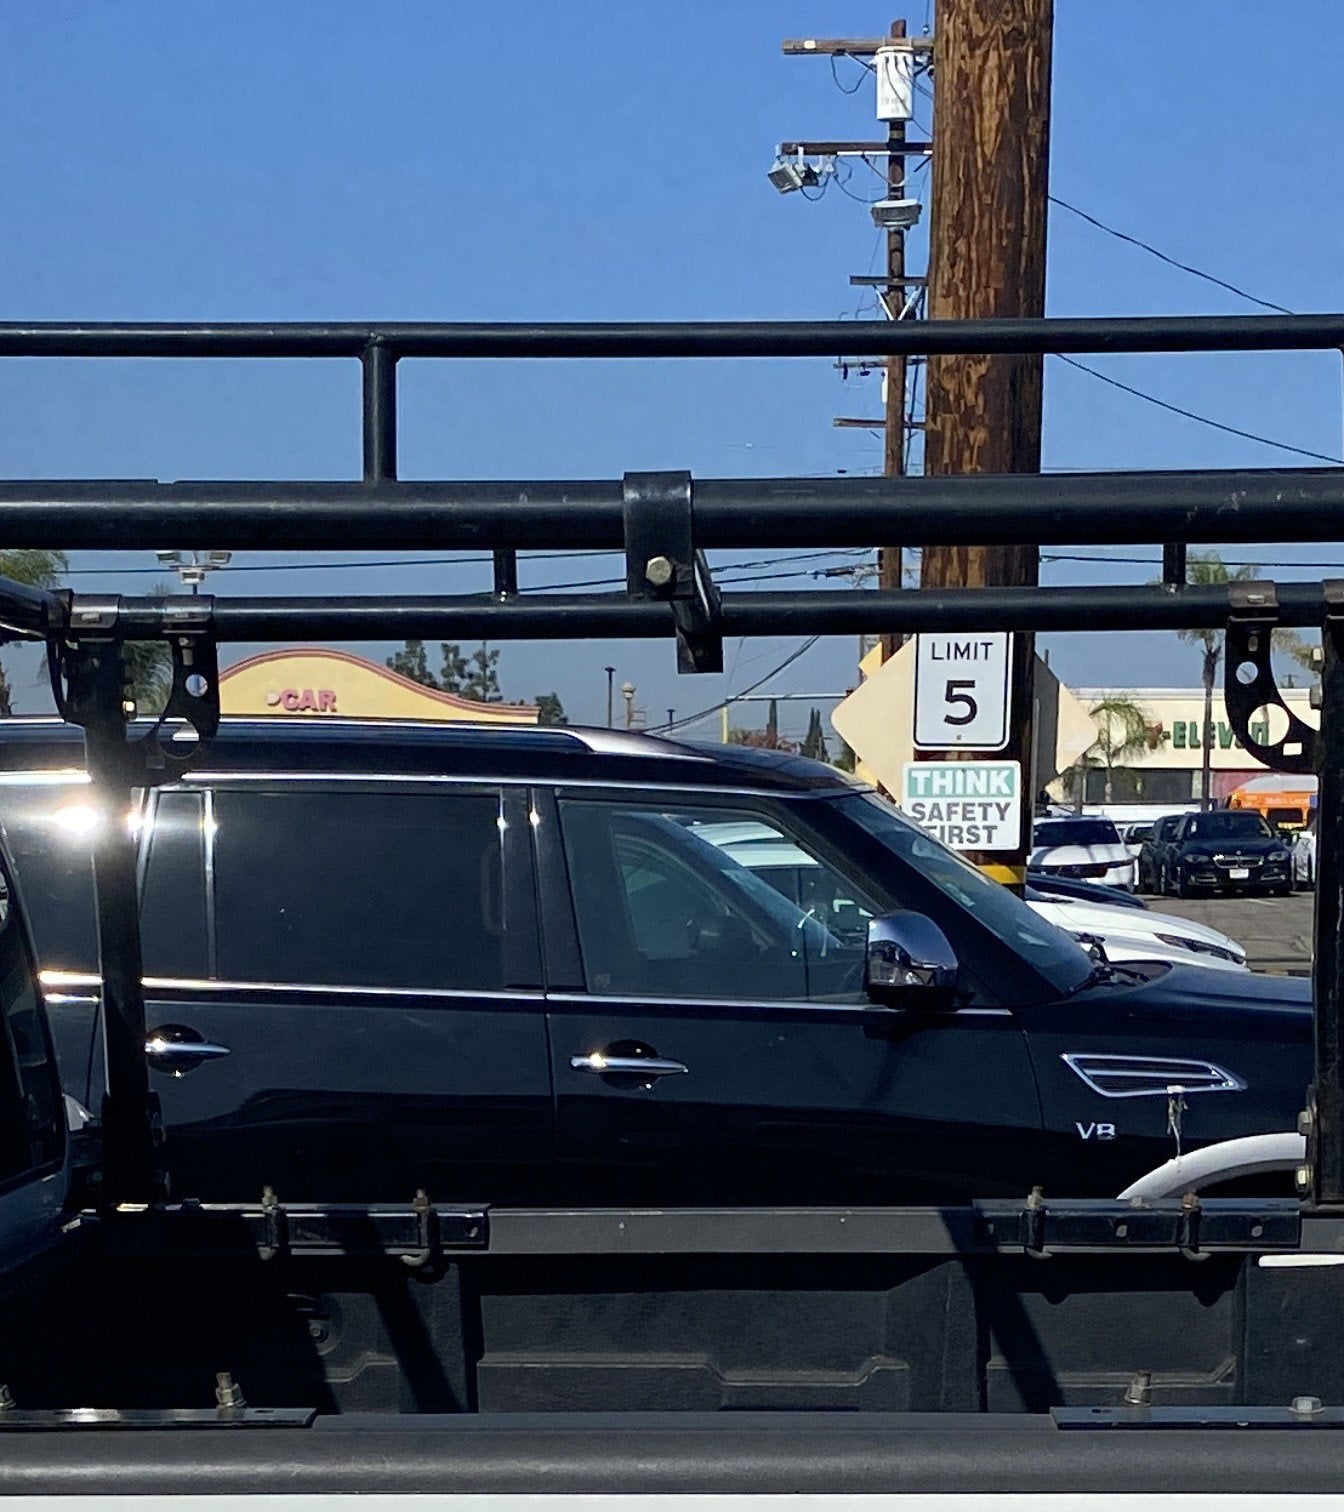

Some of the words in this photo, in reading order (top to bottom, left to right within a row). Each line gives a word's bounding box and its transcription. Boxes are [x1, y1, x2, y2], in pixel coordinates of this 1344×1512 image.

[931, 641, 994, 661] LIMIT
[280, 689, 337, 712] CAR
[943, 679, 978, 726] 5
[911, 769, 1012, 796] THINK
[911, 802, 1012, 822] SAFETY
[1074, 1121, 1116, 1140] V8
